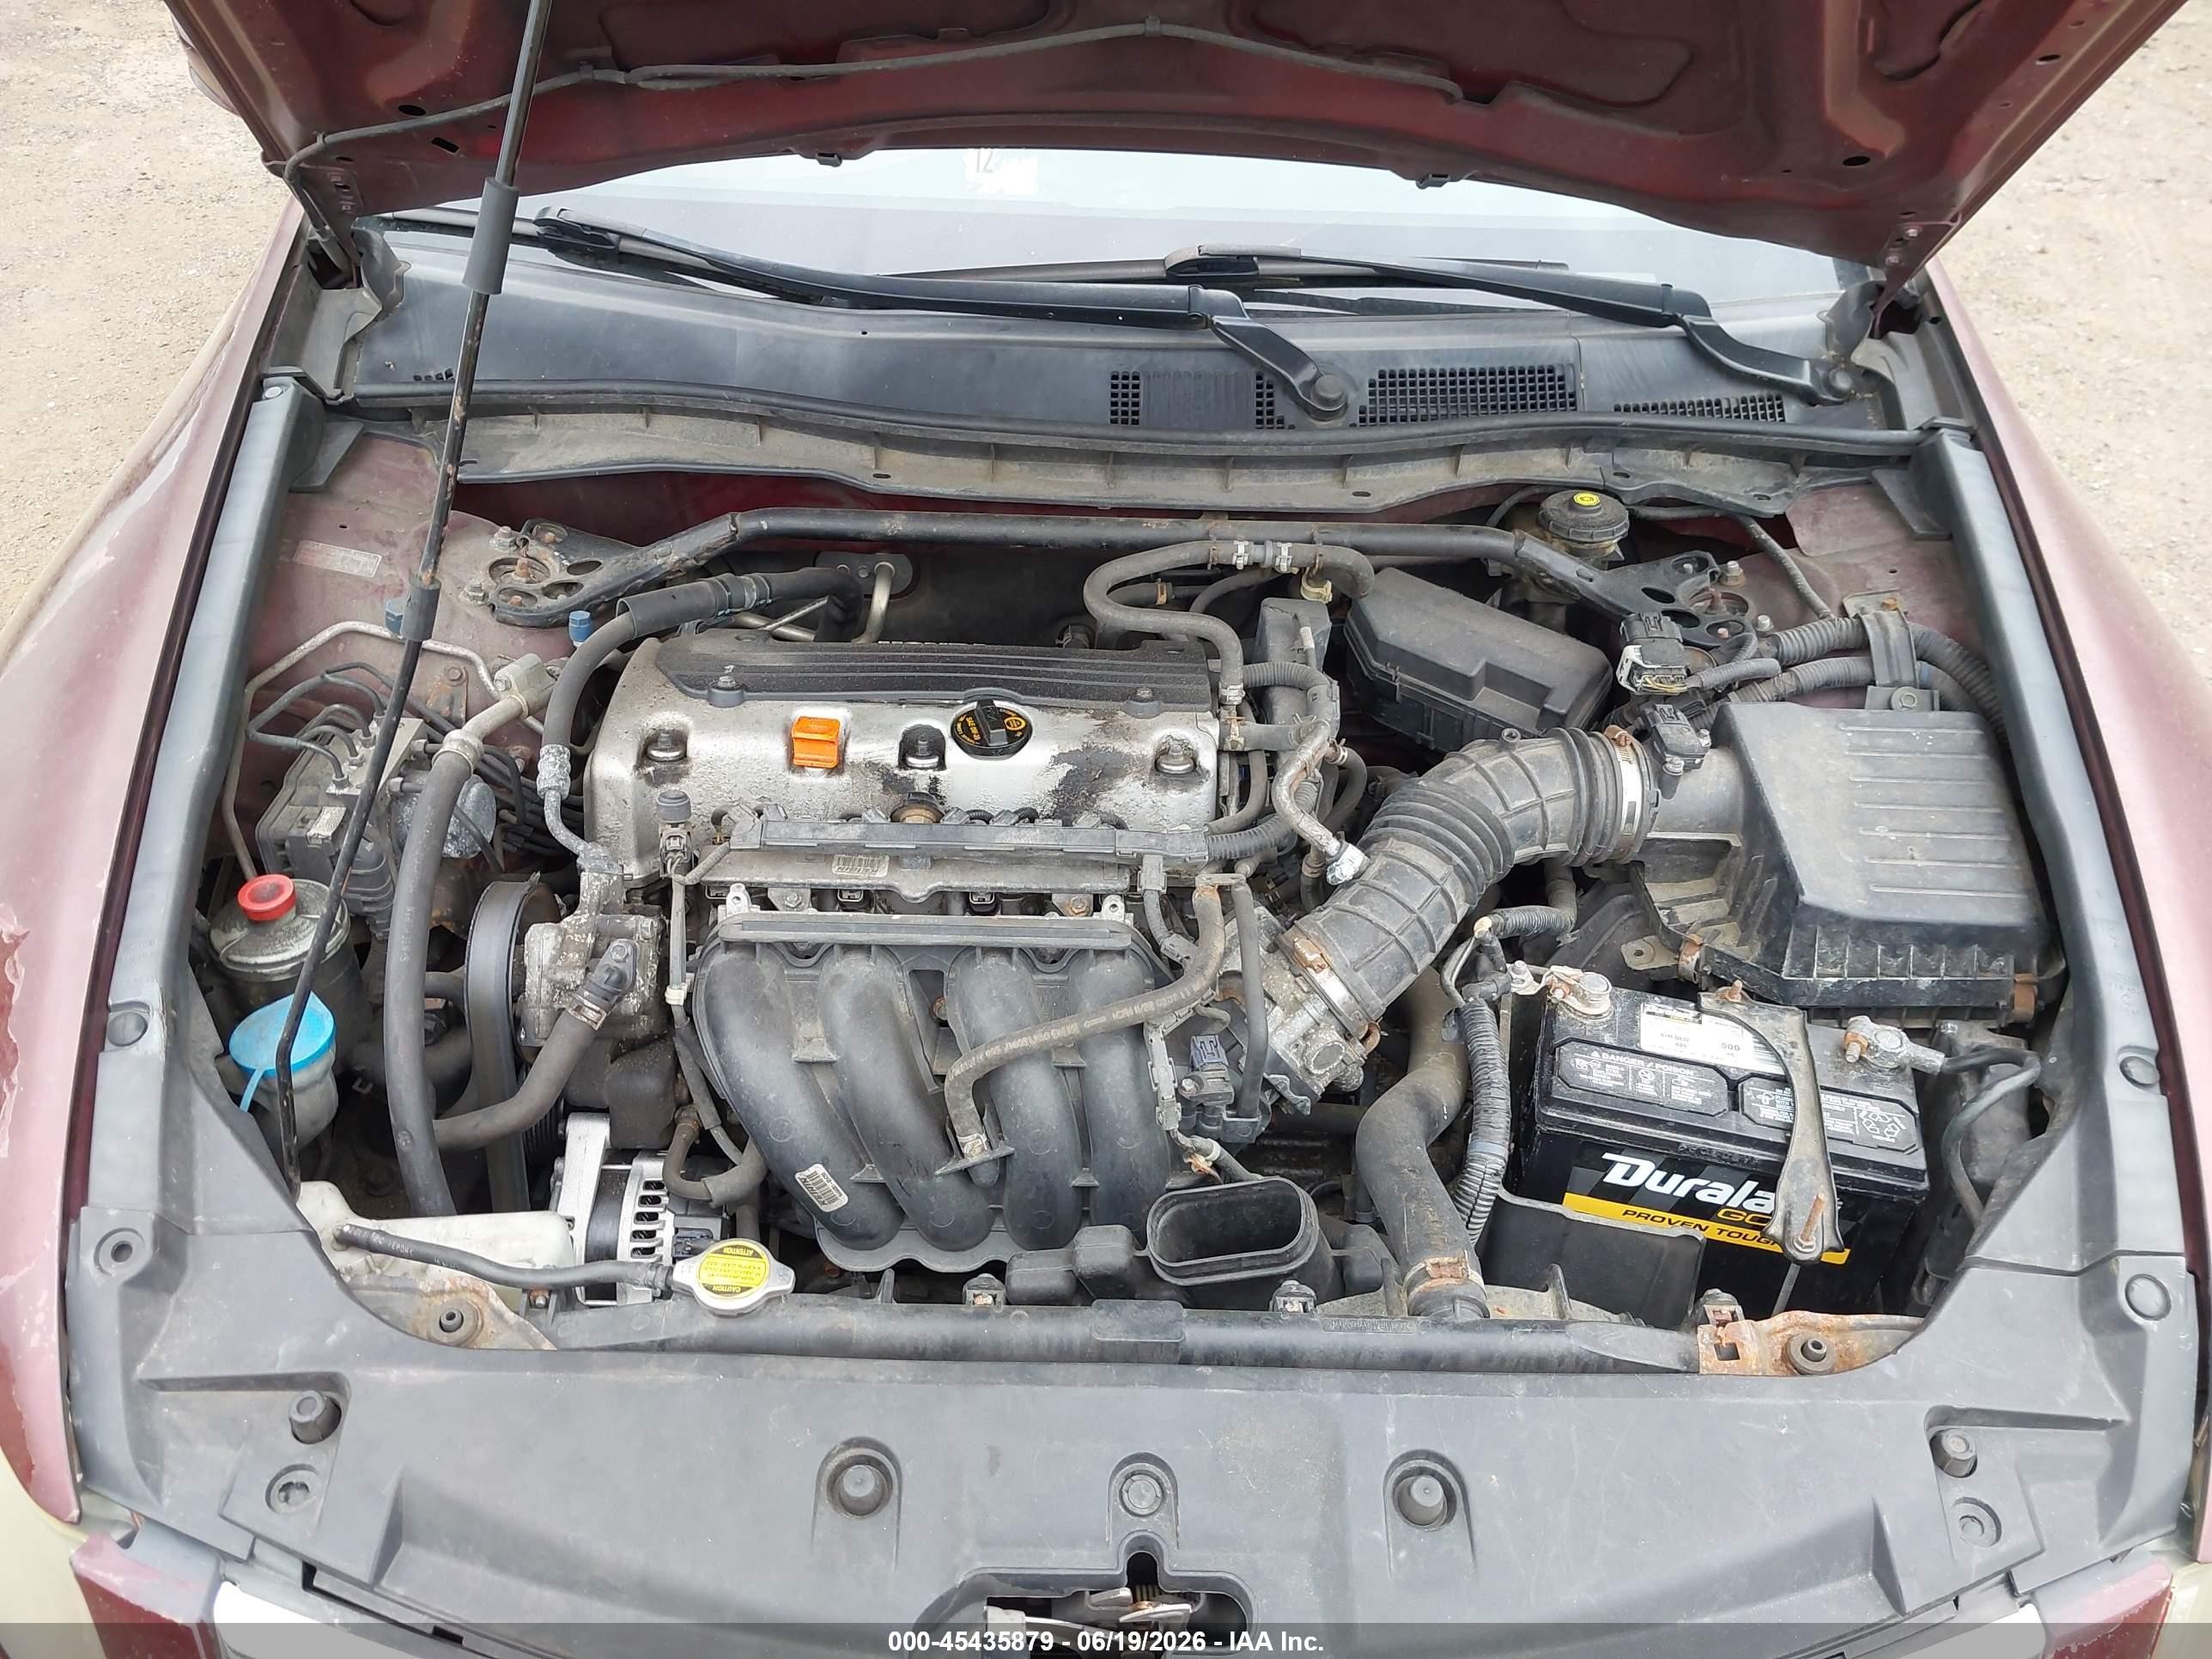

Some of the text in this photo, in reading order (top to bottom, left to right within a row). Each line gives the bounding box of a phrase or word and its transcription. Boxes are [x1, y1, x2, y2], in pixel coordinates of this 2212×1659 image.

[1721, 1042, 1741, 1052] 500
[1602, 1052, 1644, 1066] DANGER
[1656, 1064, 1695, 1076] POISON
[1601, 1152, 1776, 1214] Durala
[1622, 1209, 1777, 1246] PROVEN TOUG
[722, 1247, 754, 1257] ATTENTION
[712, 1284, 742, 1293] CAUTION
